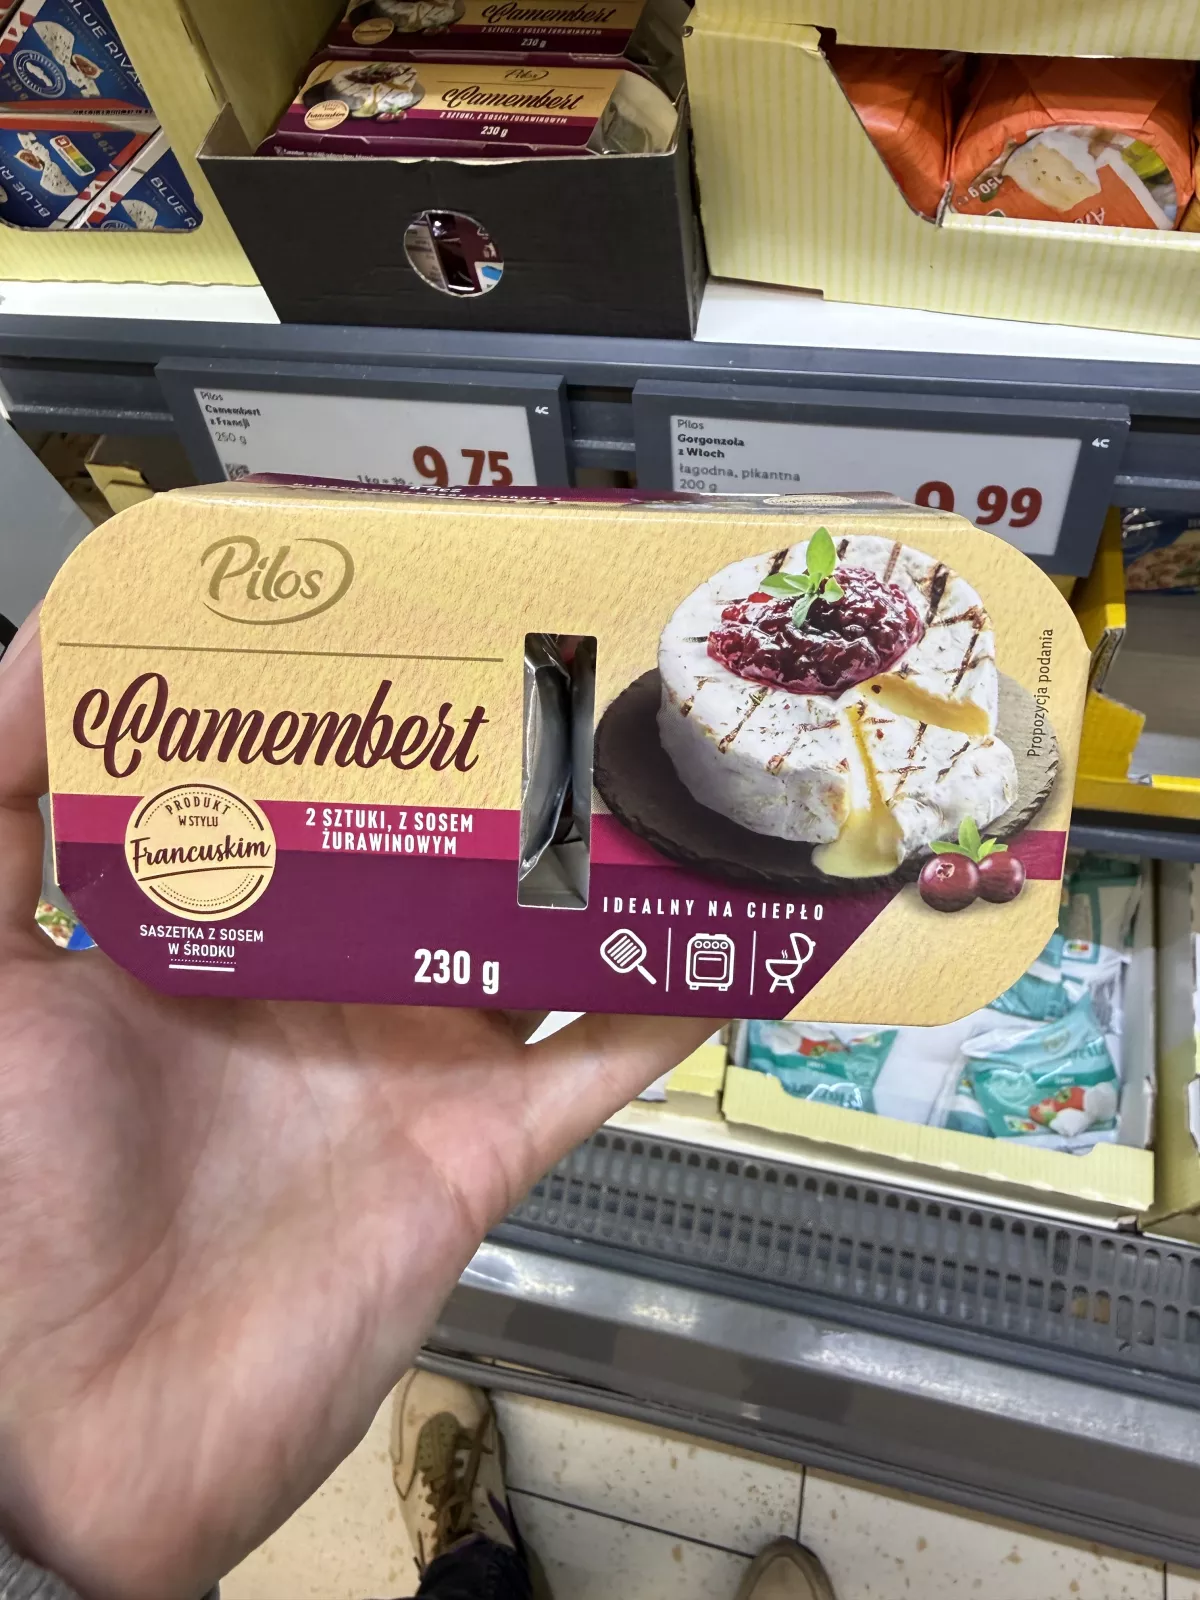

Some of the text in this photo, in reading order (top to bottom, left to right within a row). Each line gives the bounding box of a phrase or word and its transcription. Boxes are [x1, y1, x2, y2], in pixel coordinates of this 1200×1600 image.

[481, 2, 616, 24] Camembert
[441, 85, 584, 110] Camembert
[480, 126, 509, 138] 230 g
[150, 176, 187, 216] BLUE
[978, 178, 1004, 196] 150
[13, 181, 51, 218] BLUE
[200, 391, 224, 401] Pilos
[205, 404, 261, 416] Camembert
[677, 419, 704, 430] Pilos
[215, 431, 247, 445] 250 g
[677, 433, 745, 447] Gorgonzola
[687, 447, 725, 459] Włoch
[412, 445, 513, 487] 9 75
[680, 463, 801, 482] łagodna, pikantna
[680, 479, 718, 493] 200 g
[975, 484, 1043, 528] 99
[200, 534, 324, 602] Pilos
[1026, 628, 1054, 758] Propozycja podania
[72, 671, 490, 779] Camembert
[165, 795, 231, 816] PRODUKT
[178, 815, 219, 827] W STYLU
[304, 806, 474, 834] 2 SZTUKI, Z SOSEM
[321, 827, 458, 856] ŻURAWINOWYM
[129, 834, 272, 874] Francuskim
[602, 896, 824, 921] IDEALNY NA CIEPŁO
[139, 924, 265, 943] SASZETKA Z SOSEM
[168, 940, 236, 958] W ŚRODKU
[413, 948, 501, 995] 230 g
